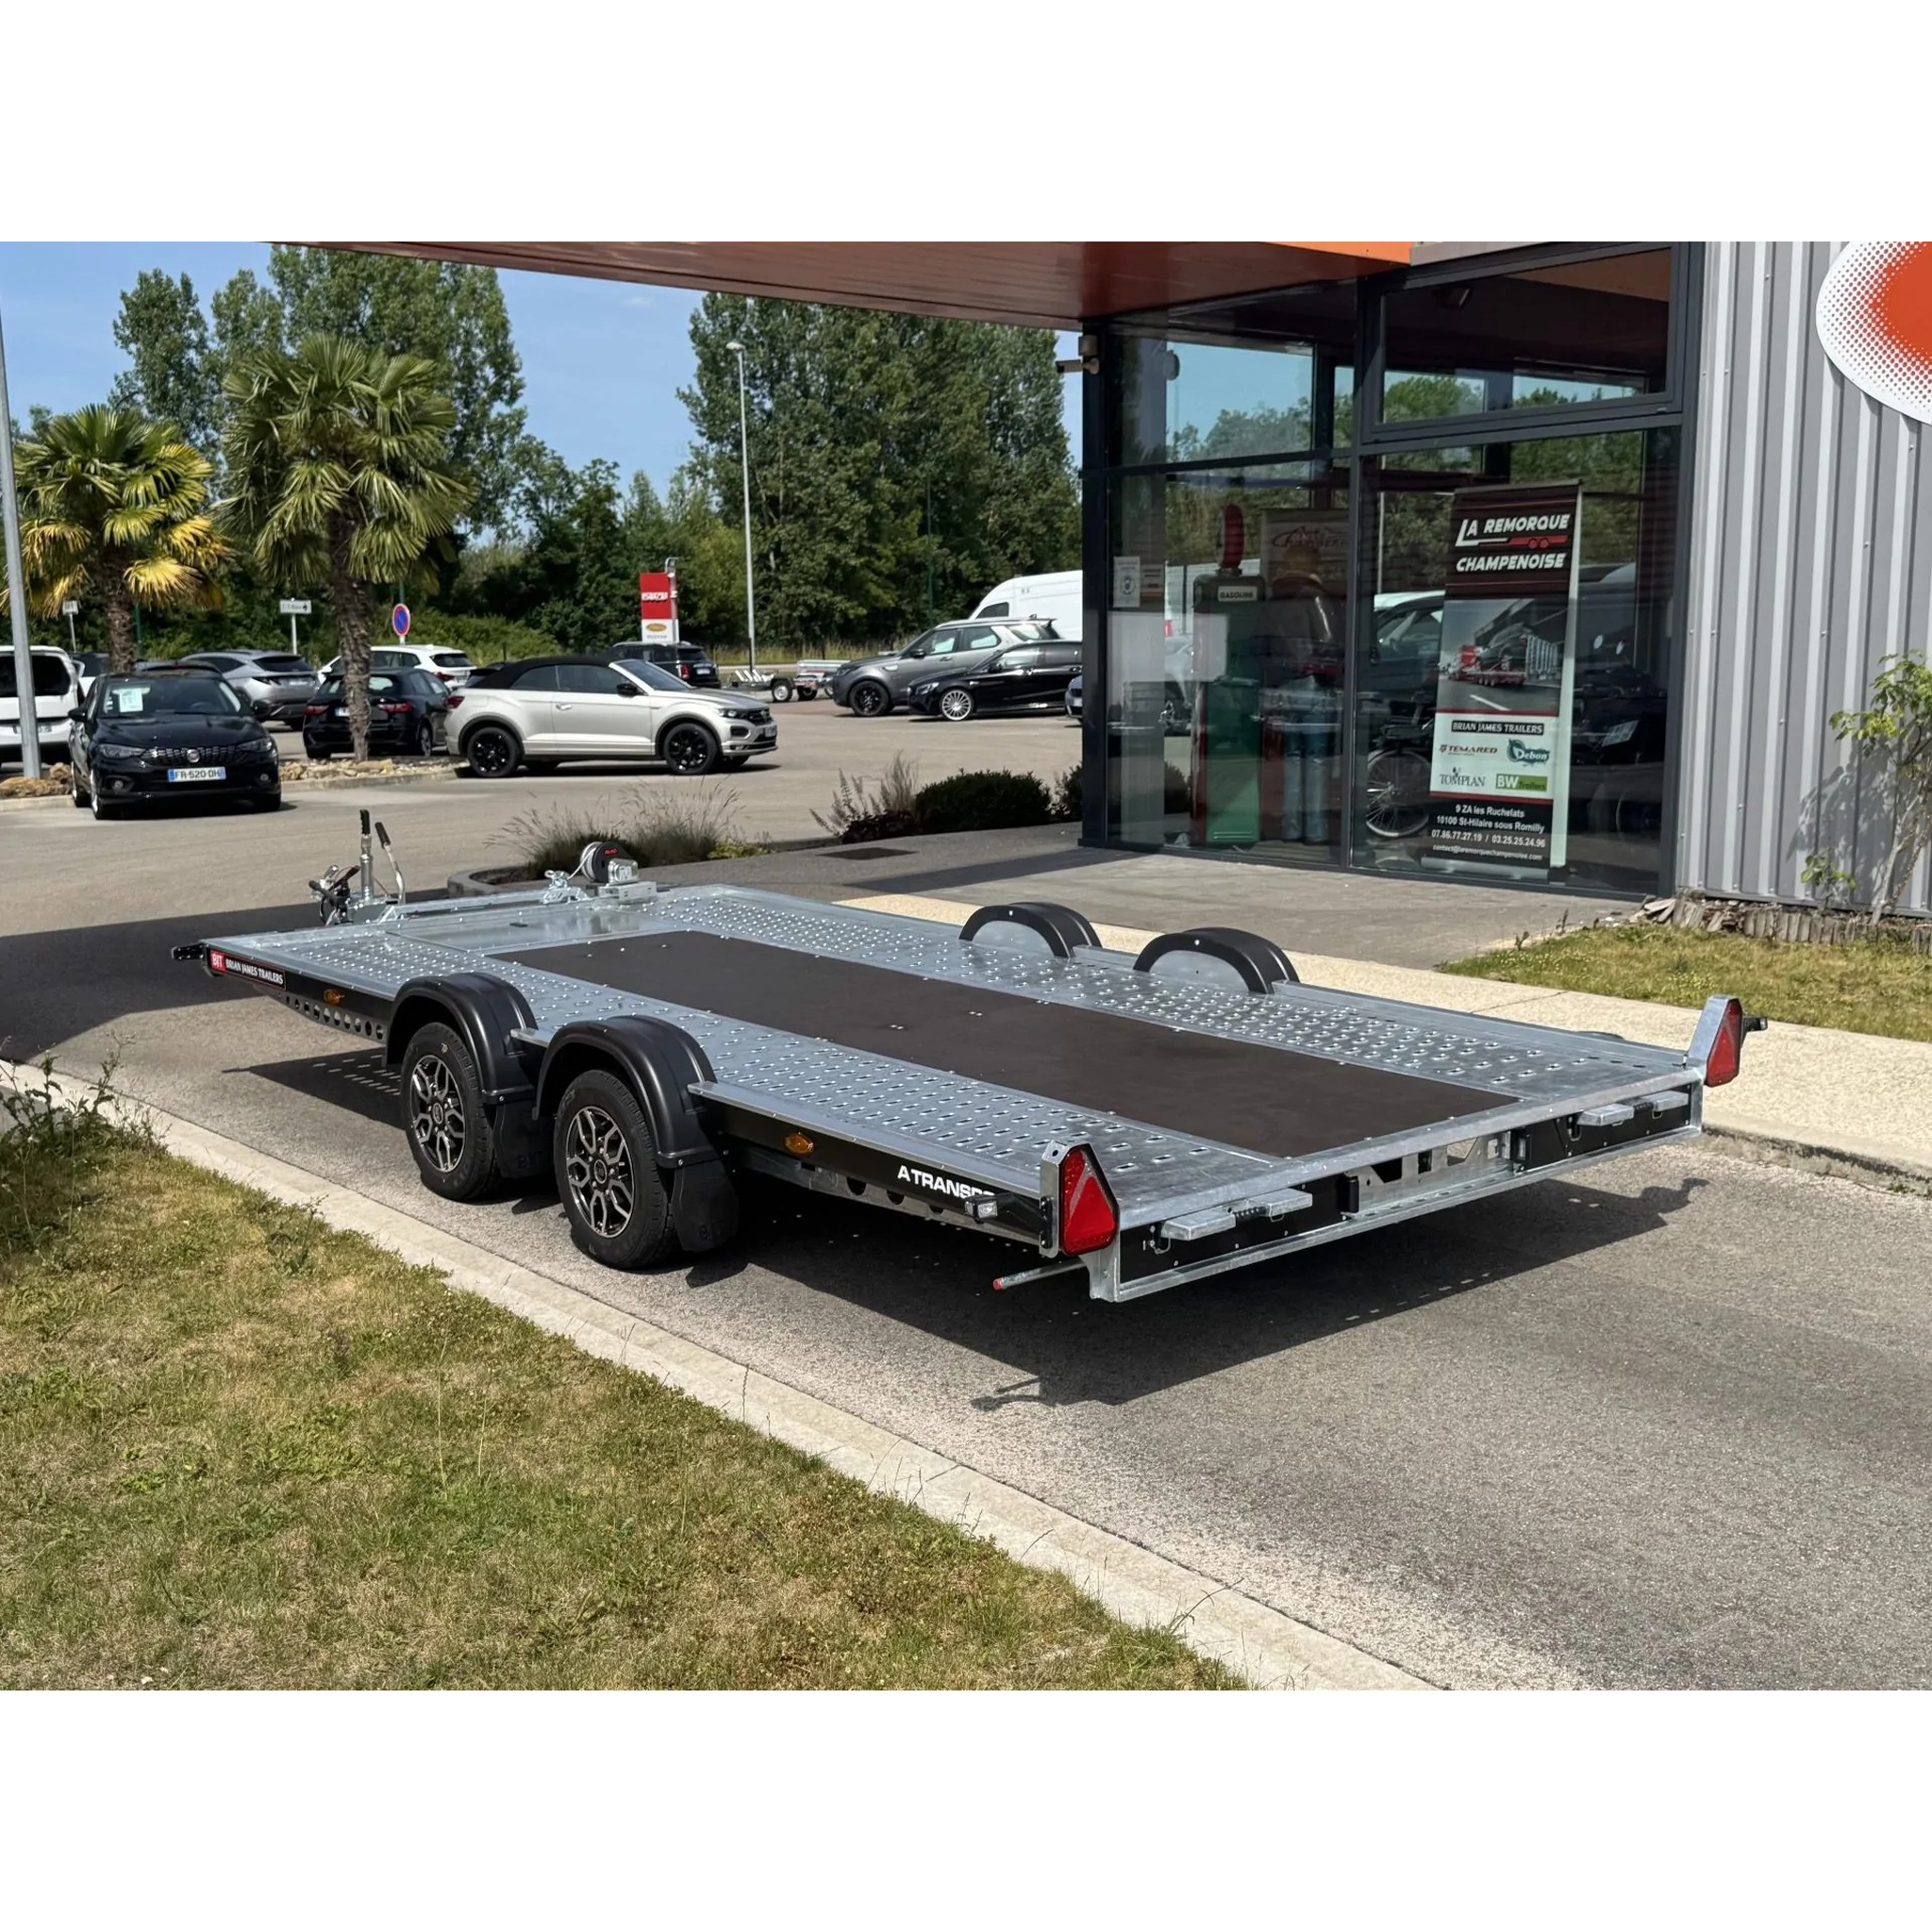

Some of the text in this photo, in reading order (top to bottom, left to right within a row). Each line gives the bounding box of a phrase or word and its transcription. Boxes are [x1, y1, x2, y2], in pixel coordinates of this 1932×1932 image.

[1455, 514, 1571, 547] LA REMORQUE
[1456, 553, 1567, 573] CHAMPENOISE
[1452, 721, 1543, 734] BRIAN JAMES TRAILERS
[1447, 744, 1498, 754] TEMARED
[1516, 748, 1548, 760] Debon
[1440, 773, 1486, 788] TOMPLAN
[1496, 774, 1519, 789] BW
[1456, 804, 1461, 813] 9
[1461, 805, 1473, 814] ZA
[1474, 805, 1485, 815] les
[1437, 815, 1545, 834] 10100 St-Hilaire sous Romilly
[210, 950, 224, 968] BIT
[225, 958, 284, 985] BRIAN JAMES TRAILERS
[910, 1169, 995, 1199] TRANSP
